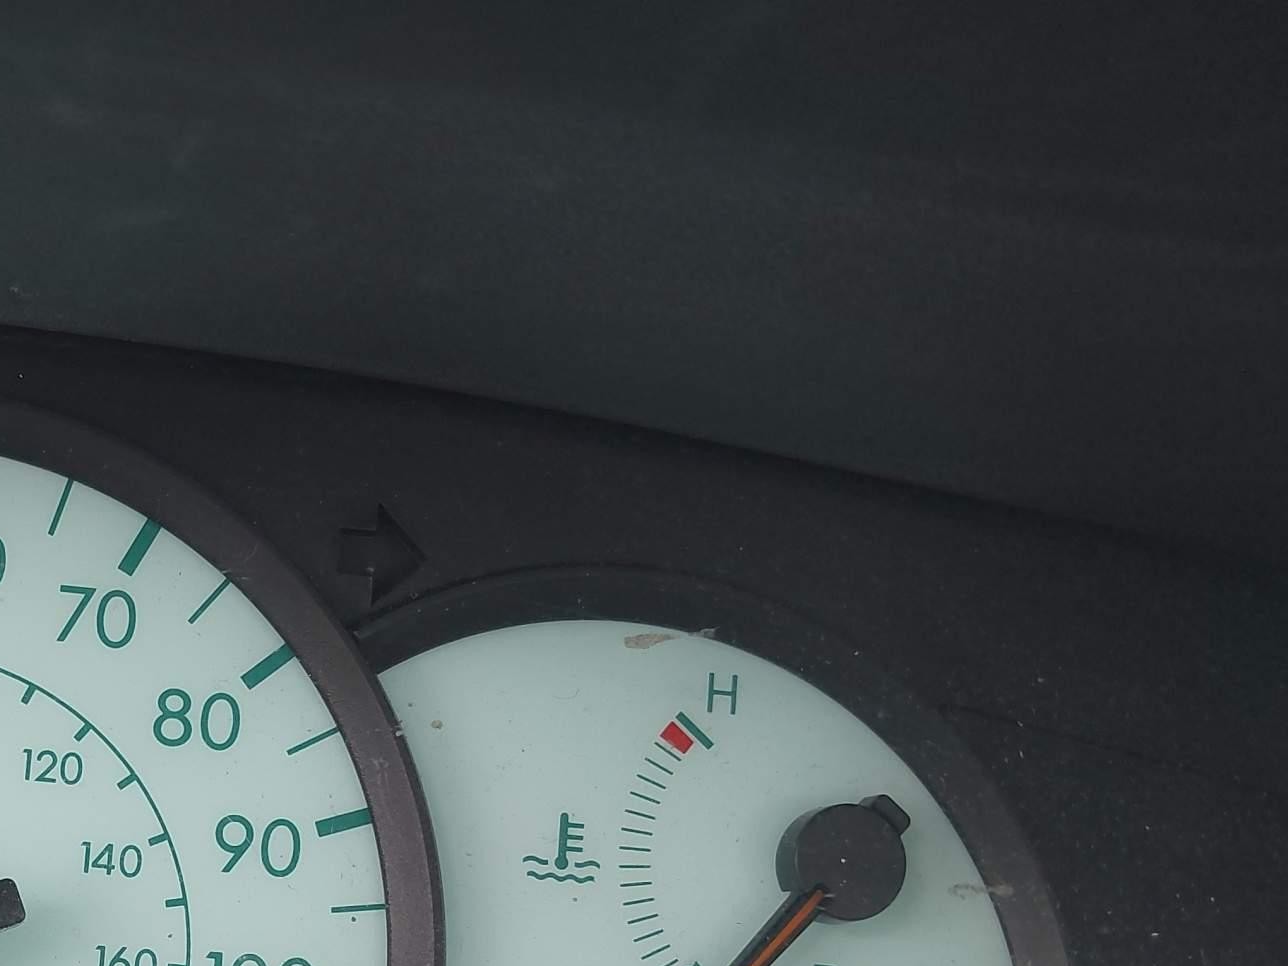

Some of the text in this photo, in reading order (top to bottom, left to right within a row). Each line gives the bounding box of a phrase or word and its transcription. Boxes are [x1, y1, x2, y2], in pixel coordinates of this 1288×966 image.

[57, 585, 137, 649] 70
[153, 688, 240, 750] 80
[707, 672, 738, 715] H
[22, 749, 83, 785] 120
[81, 842, 142, 878] 140
[215, 815, 301, 878] 90
